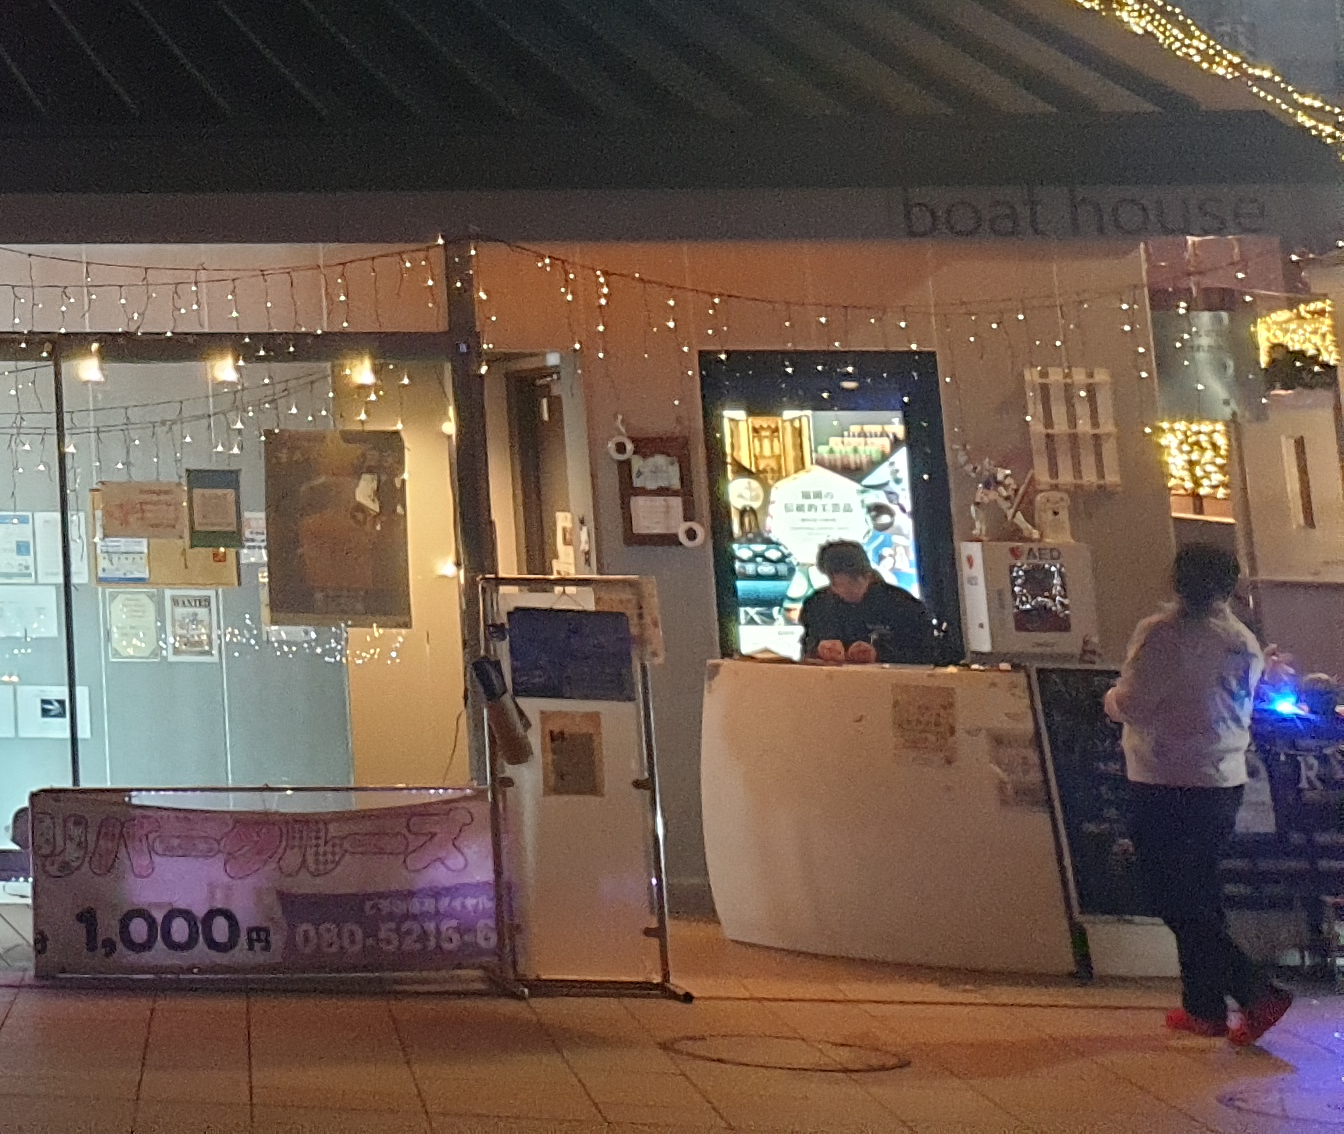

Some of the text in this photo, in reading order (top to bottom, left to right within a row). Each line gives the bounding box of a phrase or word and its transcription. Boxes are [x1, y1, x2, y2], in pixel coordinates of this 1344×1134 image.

[903, 184, 1266, 238] boat house
[1025, 547, 1062, 561] AED
